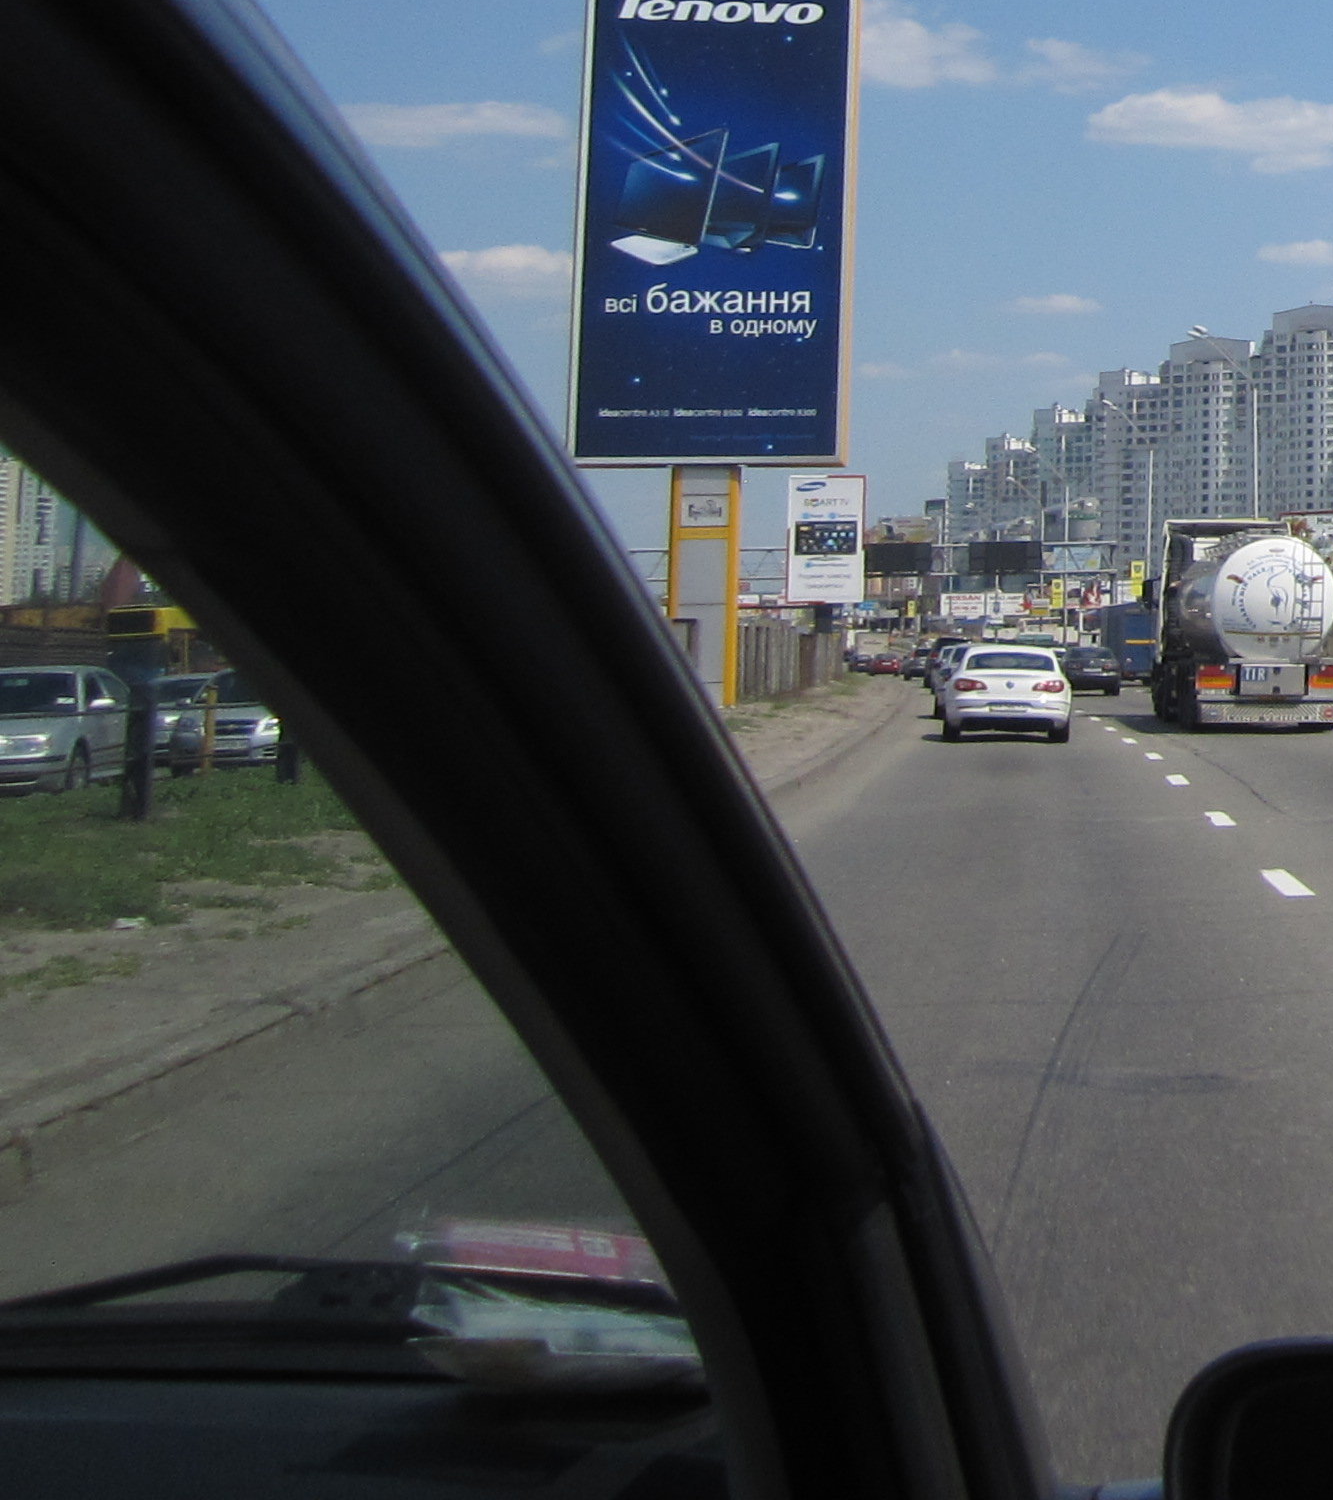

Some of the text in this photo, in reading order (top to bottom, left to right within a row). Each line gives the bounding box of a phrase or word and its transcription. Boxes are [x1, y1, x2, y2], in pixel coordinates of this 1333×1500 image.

[604, 282, 811, 315] всі бажання
[710, 318, 817, 339] в одному
[1244, 666, 1267, 681] TIR
